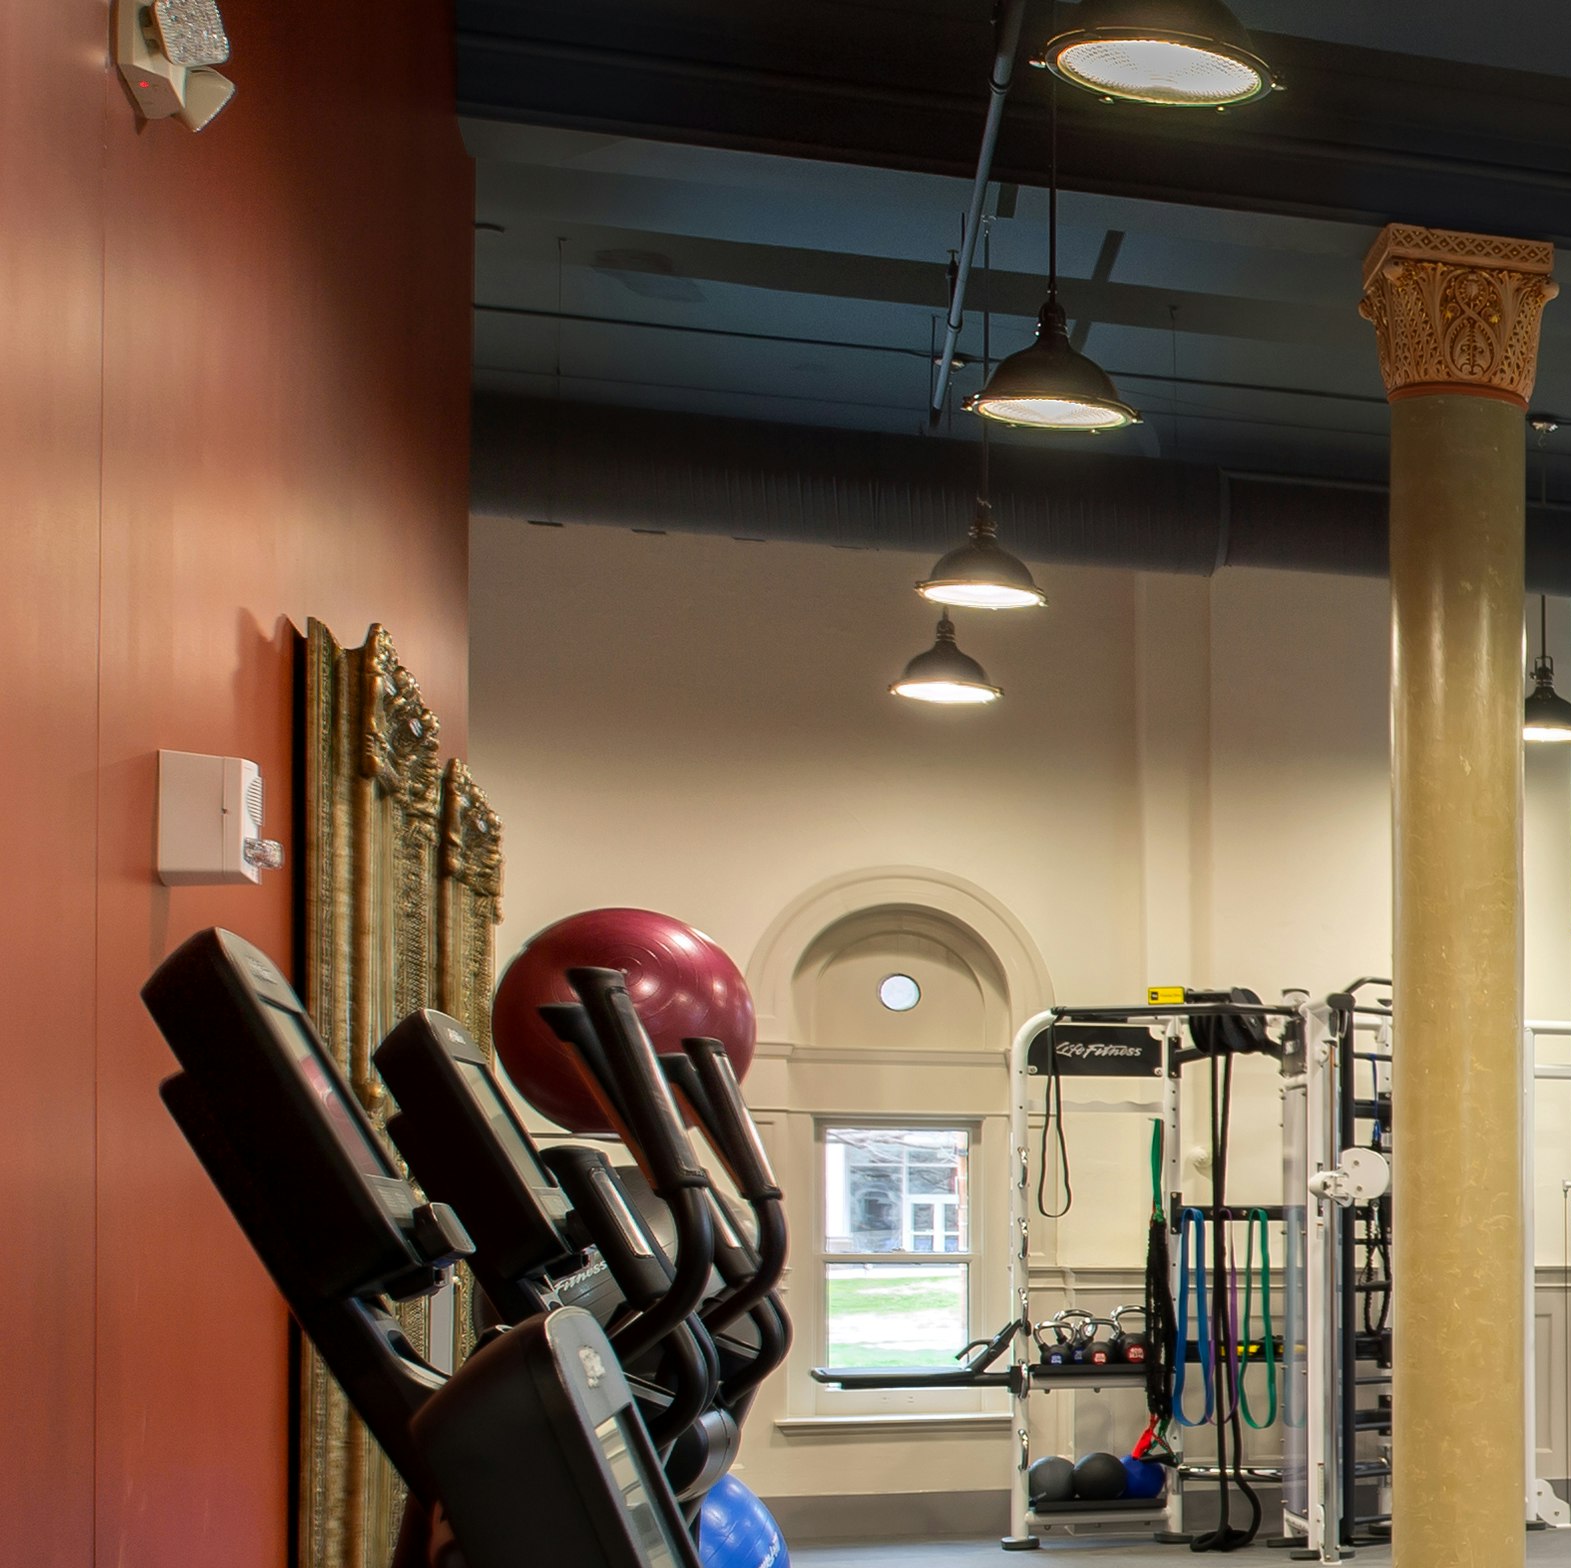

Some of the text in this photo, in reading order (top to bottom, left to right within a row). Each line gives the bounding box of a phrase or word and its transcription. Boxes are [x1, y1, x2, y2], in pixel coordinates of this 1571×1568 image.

[1056, 1042, 1142, 1059] Life Fitness
[554, 1260, 608, 1292] Fitness
